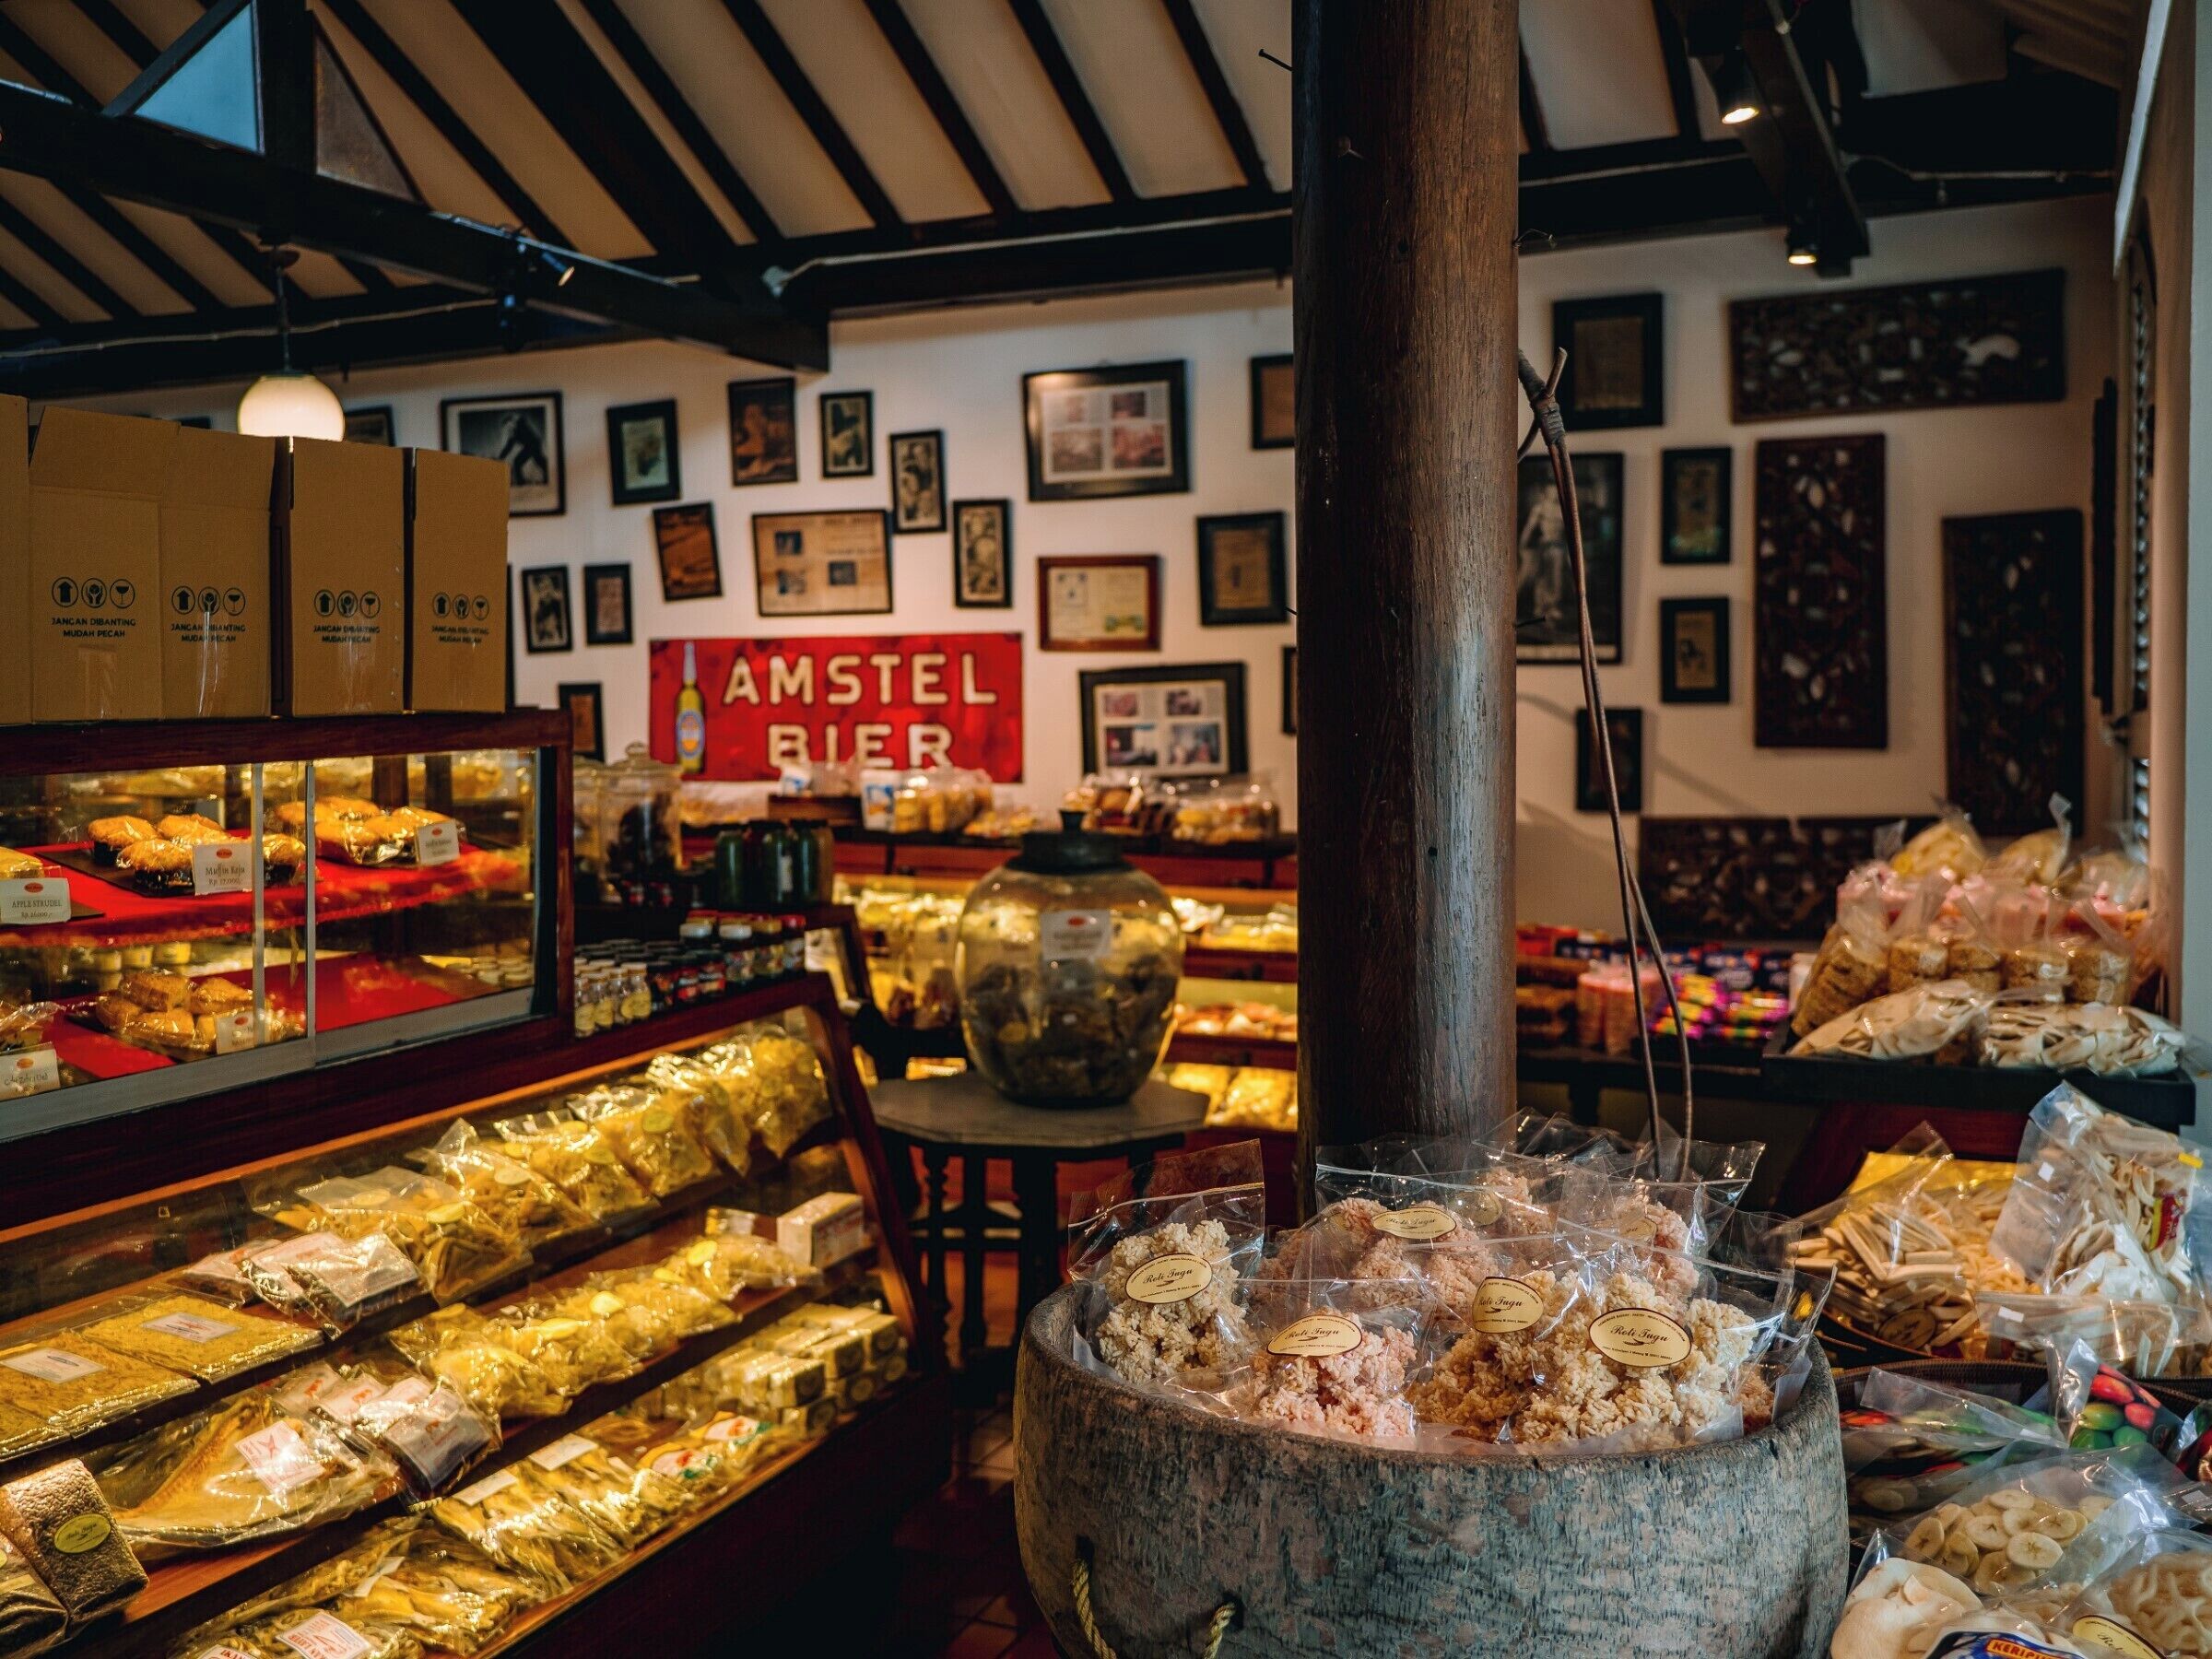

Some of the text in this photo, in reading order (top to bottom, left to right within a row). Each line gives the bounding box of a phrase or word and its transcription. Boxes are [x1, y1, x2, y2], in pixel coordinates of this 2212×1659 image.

[52, 618, 136, 627] JANGAN DIBANTING
[171, 623, 203, 632] JANGAN
[313, 625, 342, 633] JANGAN
[63, 629, 125, 638] MUDAH PECAH
[723, 653, 997, 705] AMSTEL
[768, 724, 954, 769] BIER
[12, 899, 63, 908] APPLE STRUDEL
[1143, 1272, 1165, 1284] Roti
[1167, 1267, 1194, 1280] Tugu
[1495, 1295, 1524, 1310] Tugu
[1285, 1329, 1309, 1340] Roti
[1311, 1327, 1341, 1337] Tugu
[1610, 1324, 1637, 1337] Roti
[1638, 1328, 1671, 1345] Tugu
